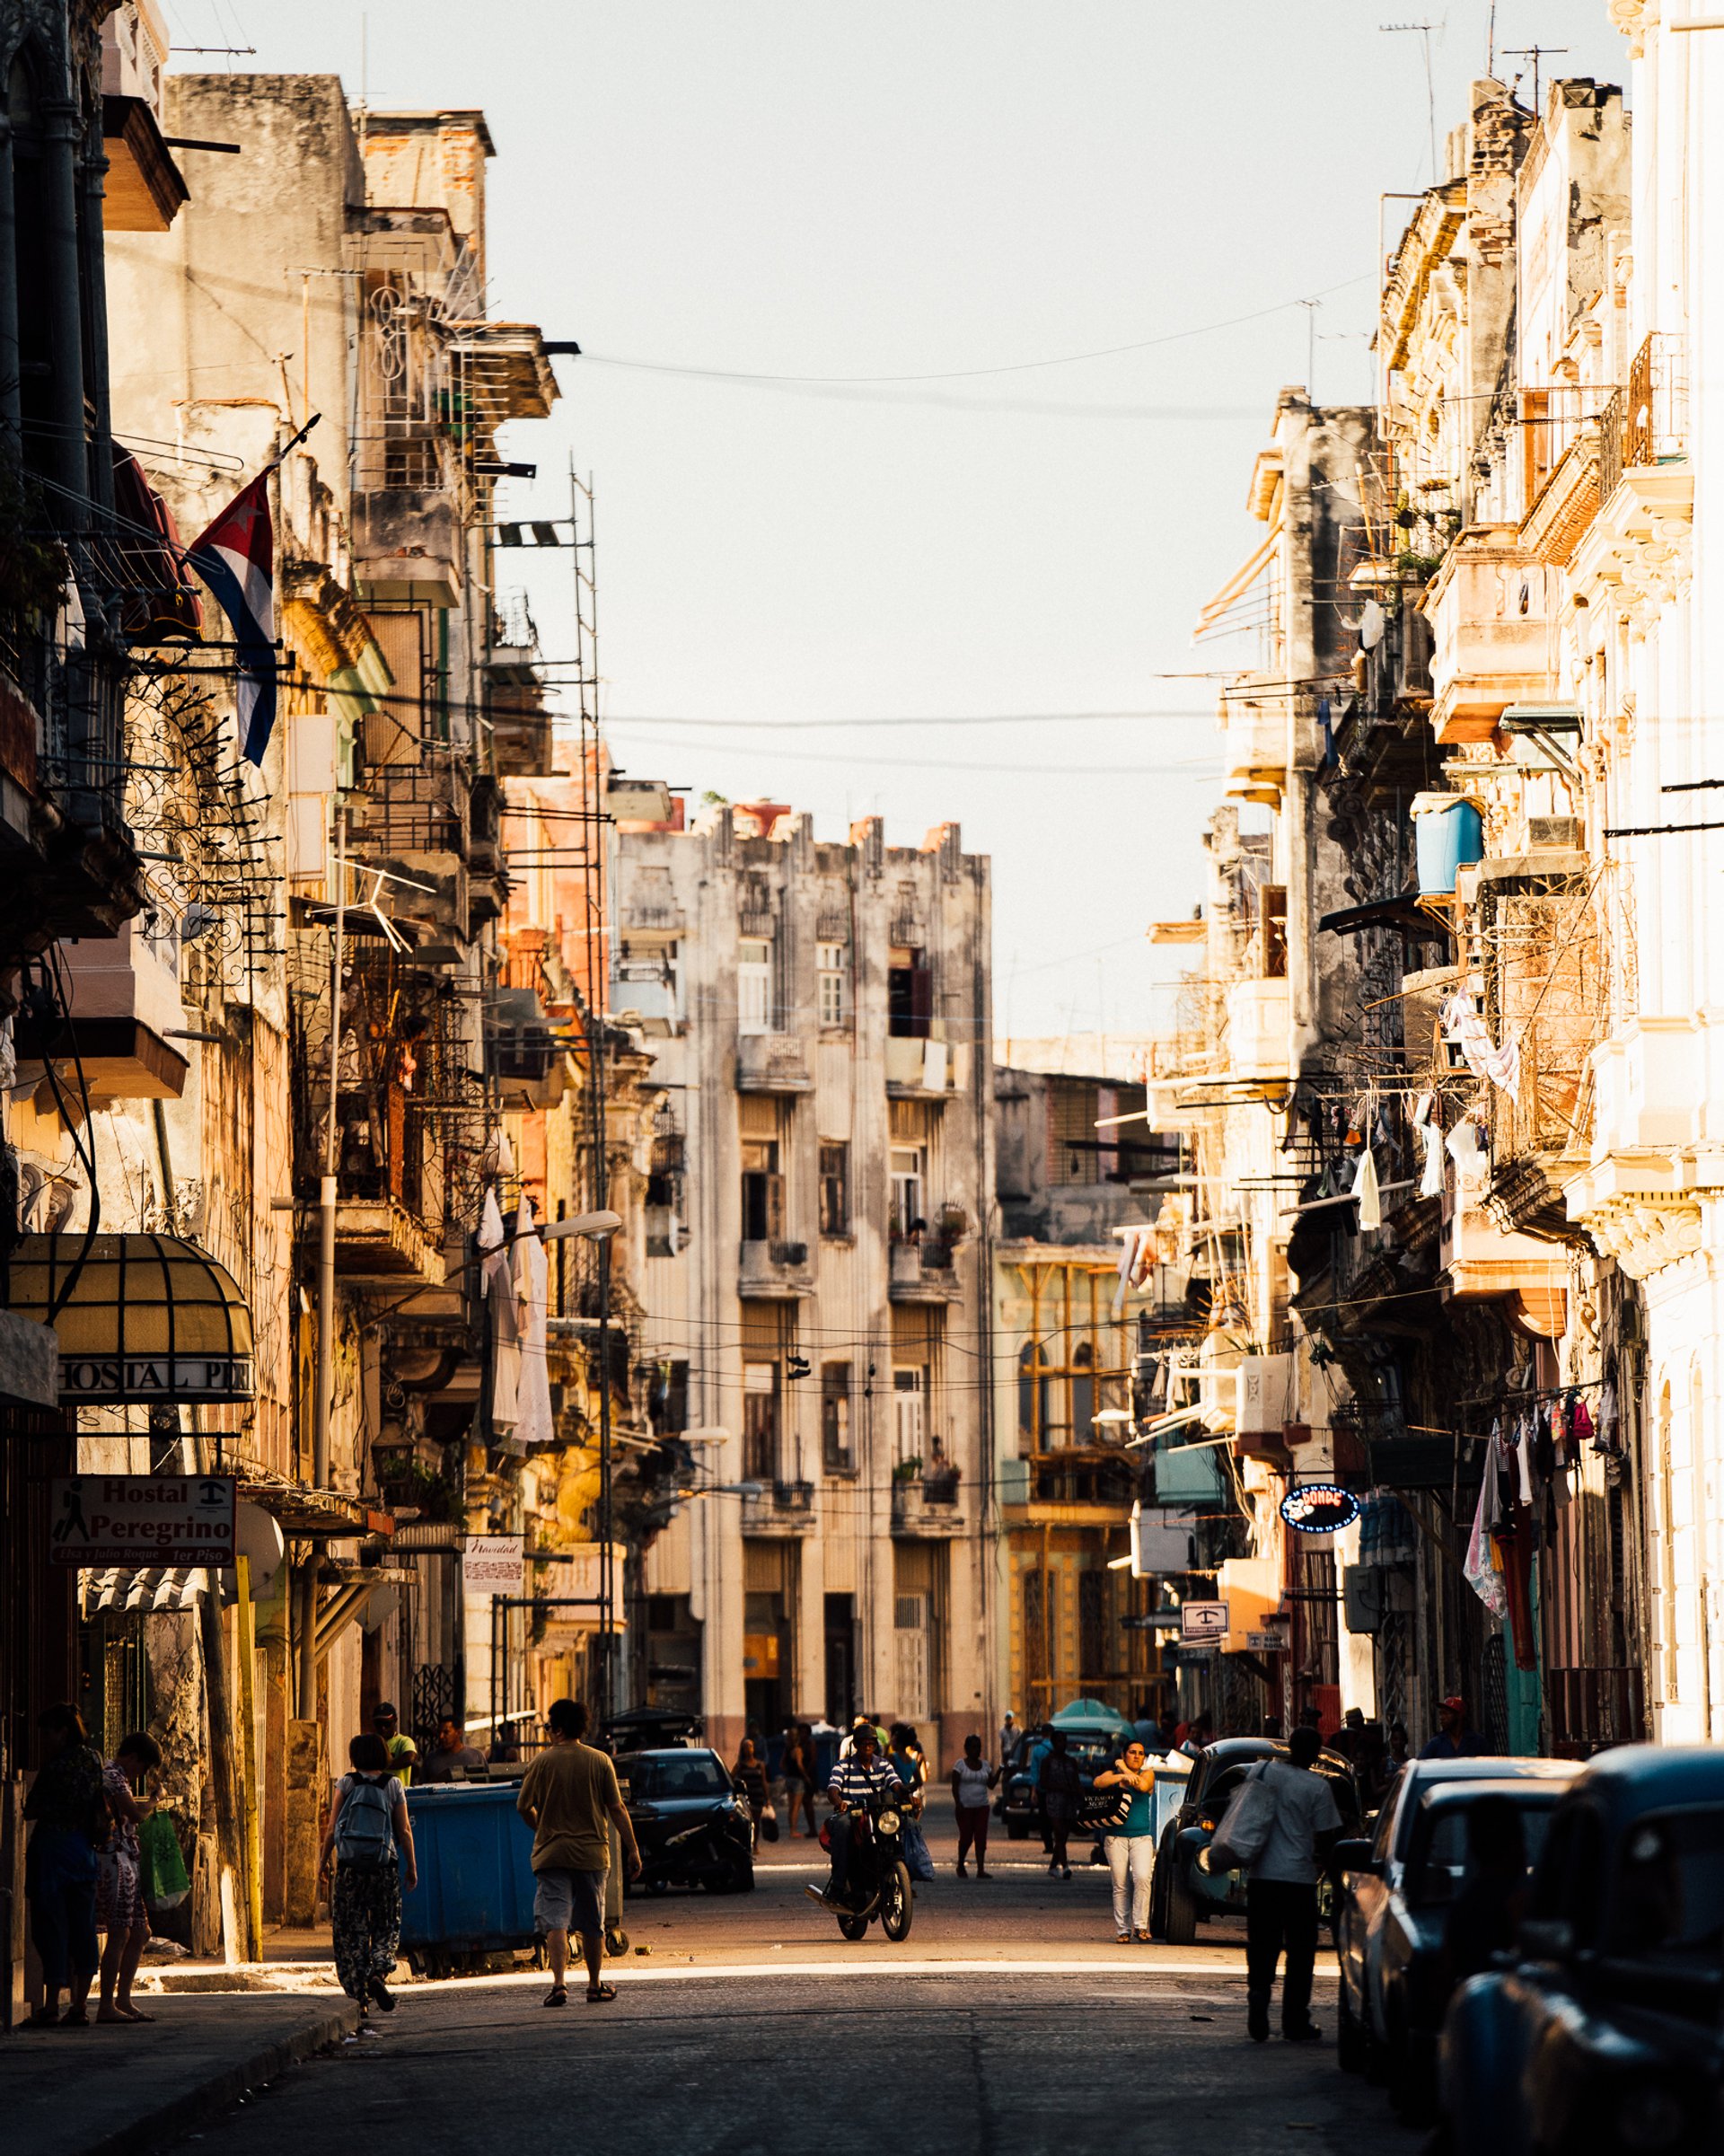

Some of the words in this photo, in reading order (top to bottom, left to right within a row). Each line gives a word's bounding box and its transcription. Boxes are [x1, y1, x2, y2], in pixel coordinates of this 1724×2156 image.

[58, 1362, 188, 1389] HOSTAL
[103, 1481, 188, 1502] Hostal
[1301, 1491, 1341, 1507] DONDE
[91, 1515, 231, 1544] Peregrino
[59, 1548, 82, 1559] Elsa
[84, 1551, 92, 1562] y
[92, 1548, 121, 1560] Julio
[123, 1548, 159, 1562] Roque
[195, 1549, 224, 1562] Piso
